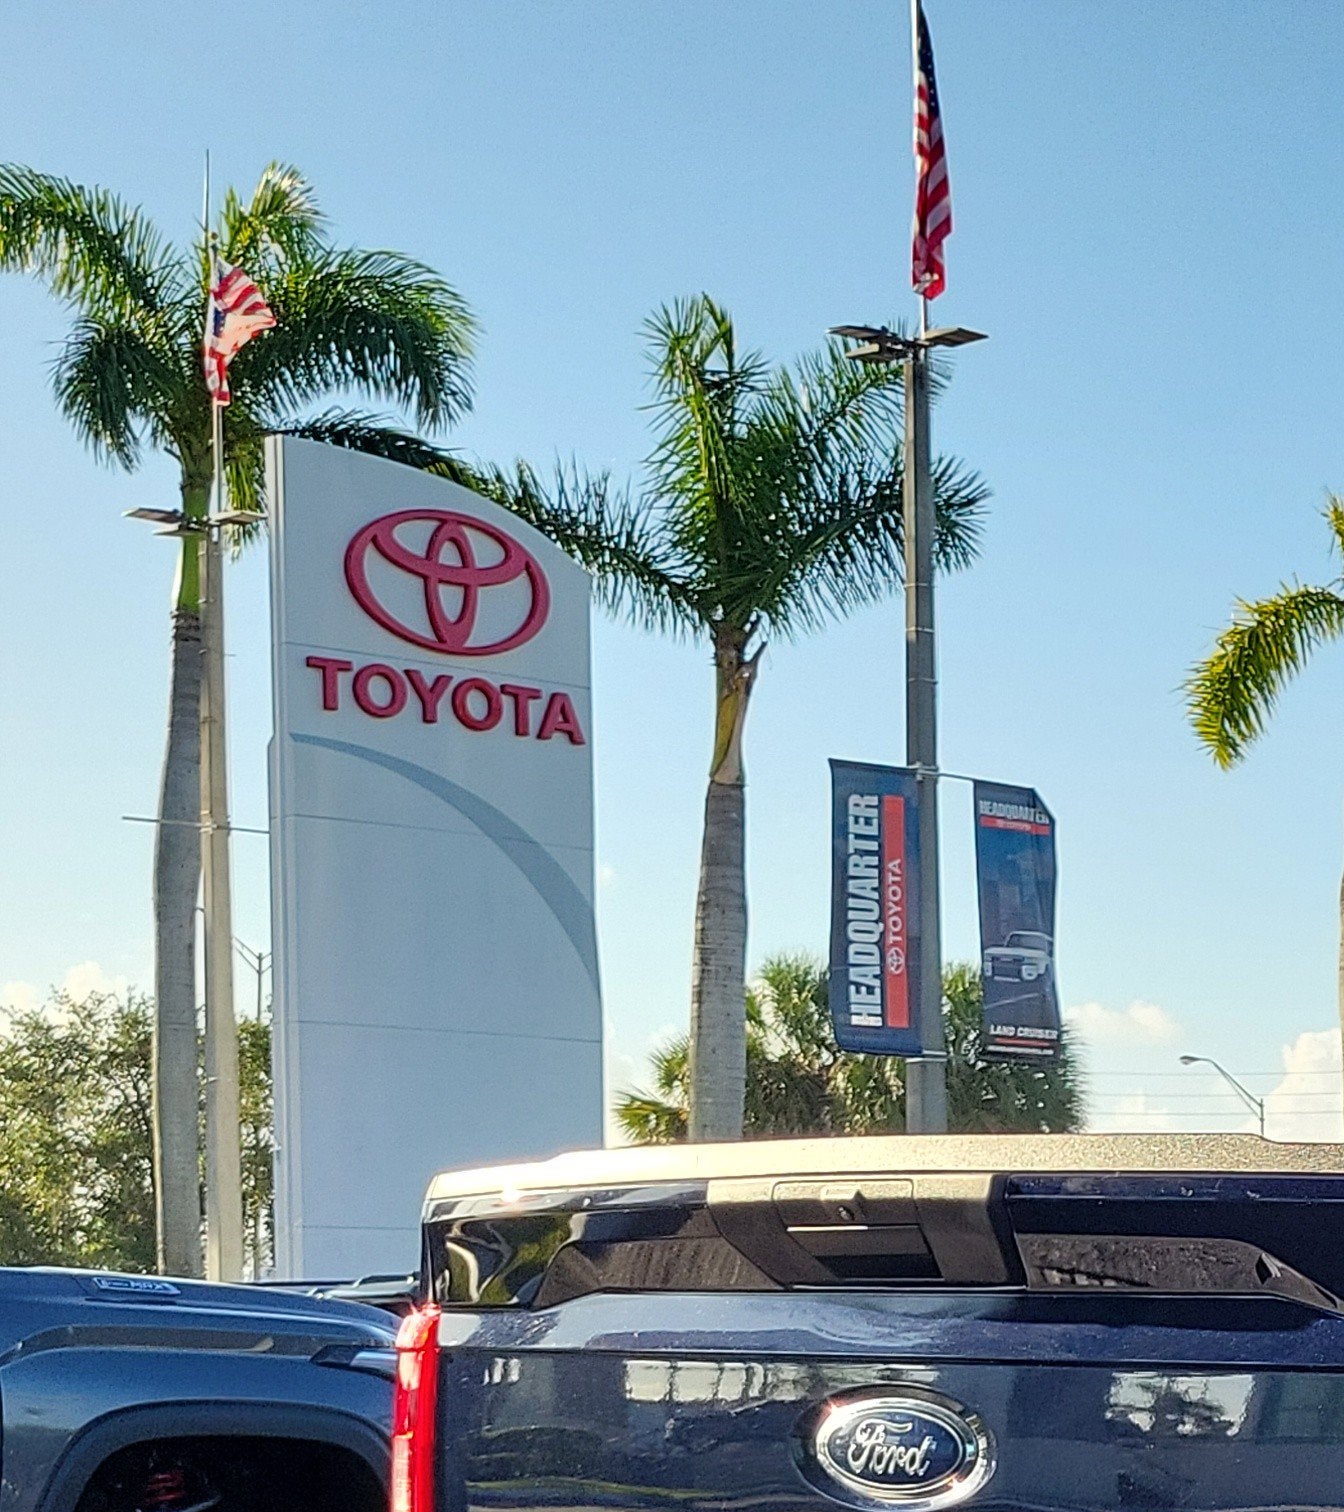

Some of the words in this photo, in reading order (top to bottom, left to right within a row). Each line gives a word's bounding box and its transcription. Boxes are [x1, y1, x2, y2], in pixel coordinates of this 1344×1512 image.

[306, 655, 586, 746] TOYOTA
[847, 794, 883, 1028] HEADQUARTER
[886, 858, 903, 945] TOYOTA
[845, 1416, 934, 1478] Ford
